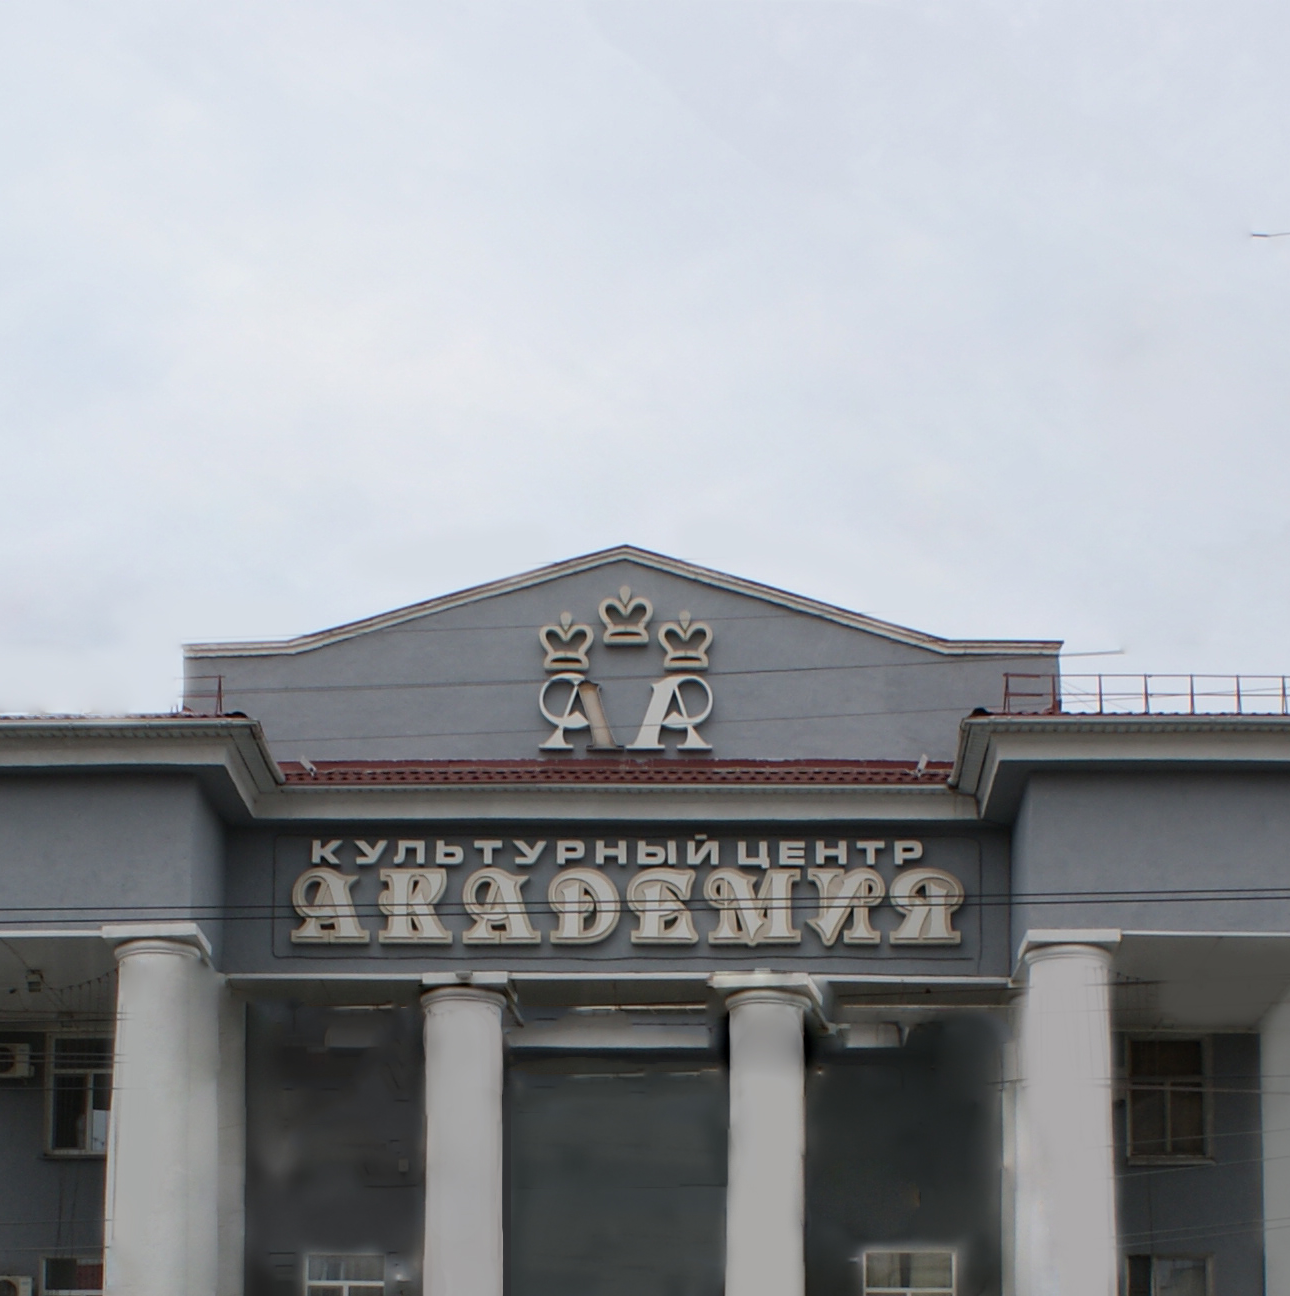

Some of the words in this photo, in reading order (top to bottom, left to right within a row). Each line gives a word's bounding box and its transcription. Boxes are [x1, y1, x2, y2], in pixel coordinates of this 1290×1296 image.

[311, 834, 720, 866] КУЛЬТУРНЫЙ
[737, 840, 924, 868] ЦЕНТР
[290, 867, 965, 946] АКАДЕМИЯ
